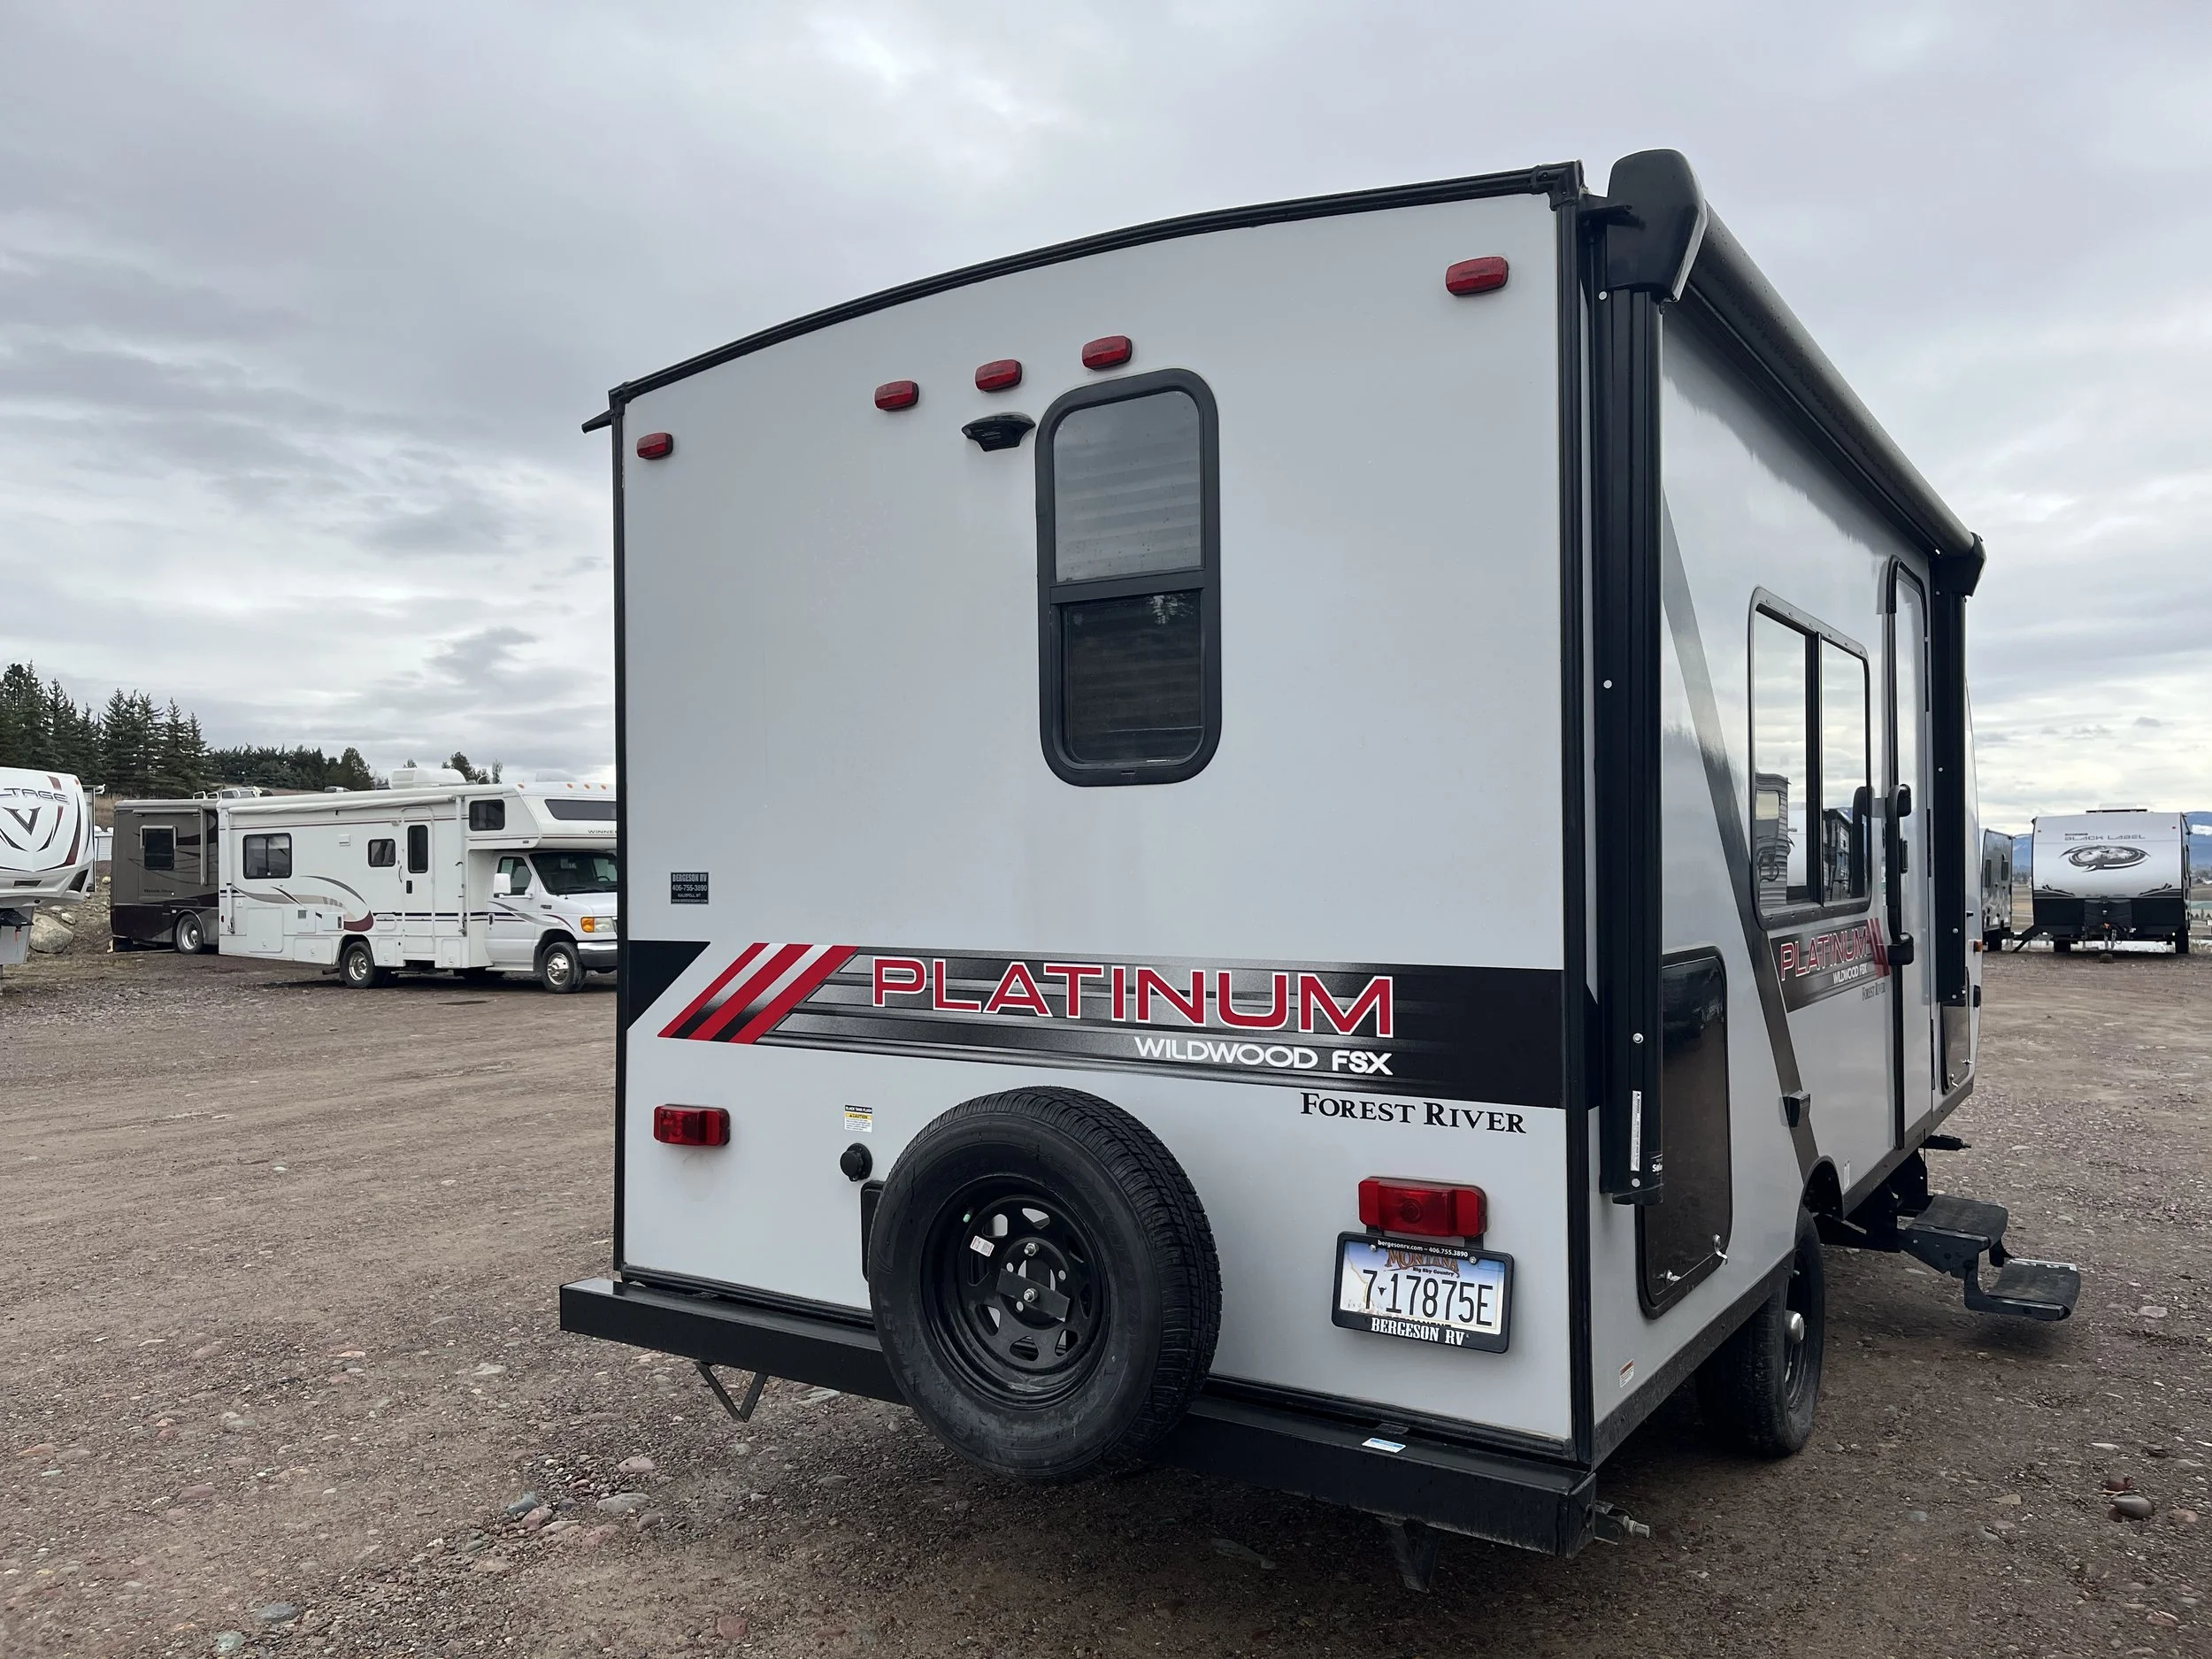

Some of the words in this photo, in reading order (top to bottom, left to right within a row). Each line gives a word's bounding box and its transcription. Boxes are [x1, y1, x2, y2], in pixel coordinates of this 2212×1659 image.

[1780, 926, 1867, 981] PLATINUM
[1832, 965, 1859, 985] WILDWOOD
[872, 956, 1394, 1039] PLATINUM
[1133, 1036, 1317, 1071] WILDWOOD
[1332, 1049, 1394, 1076] FSX
[1300, 1091, 1417, 1128] FOREST
[1423, 1101, 1527, 1135] RIVER
[1378, 1240, 1423, 1251] bergesonrv.com
[1428, 1247, 1469, 1257] 406.755.3890
[1384, 1249, 1460, 1273] MONTANA
[1371, 1317, 1440, 1343] BERGESON
[1445, 1331, 1465, 1346] RV
